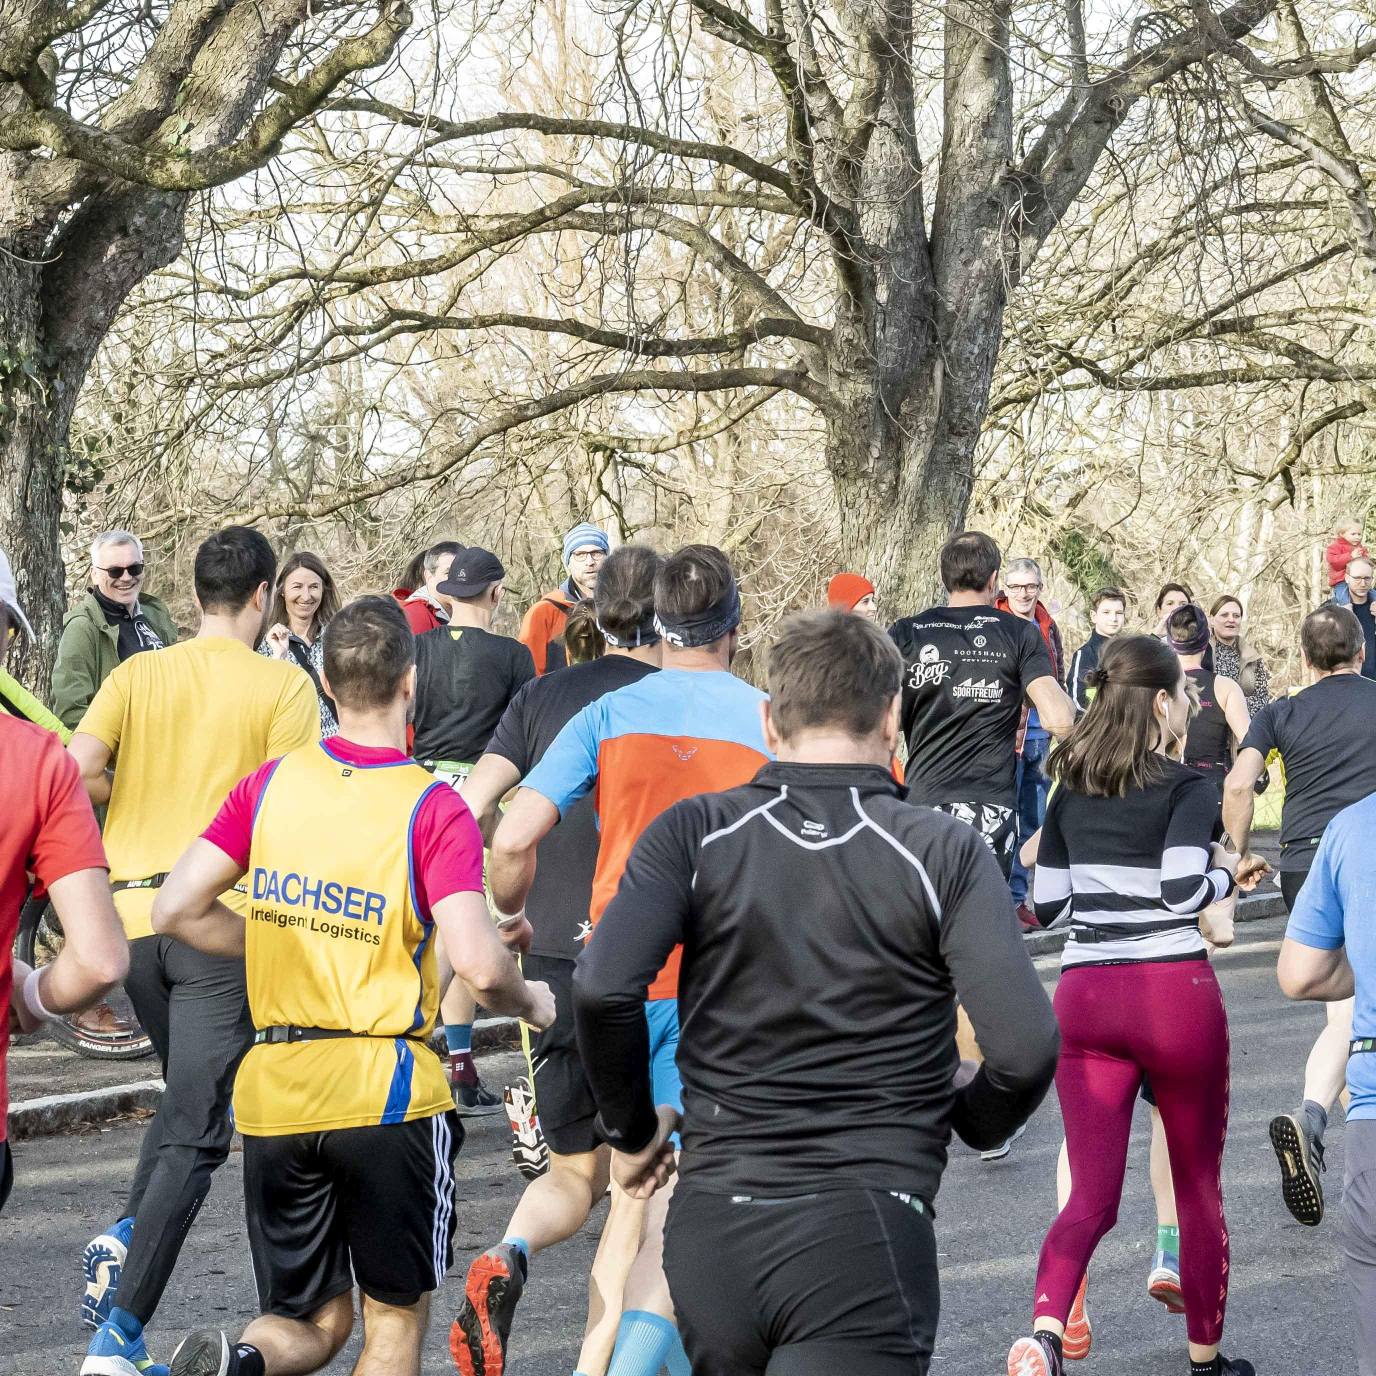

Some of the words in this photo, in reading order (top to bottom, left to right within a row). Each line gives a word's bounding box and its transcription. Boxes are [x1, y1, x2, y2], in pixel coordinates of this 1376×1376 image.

[954, 650, 1006, 658] BOOTSHAUS
[907, 662, 952, 689] Berg
[253, 867, 386, 925] DACHSER
[310, 918, 381, 946] Logistics
